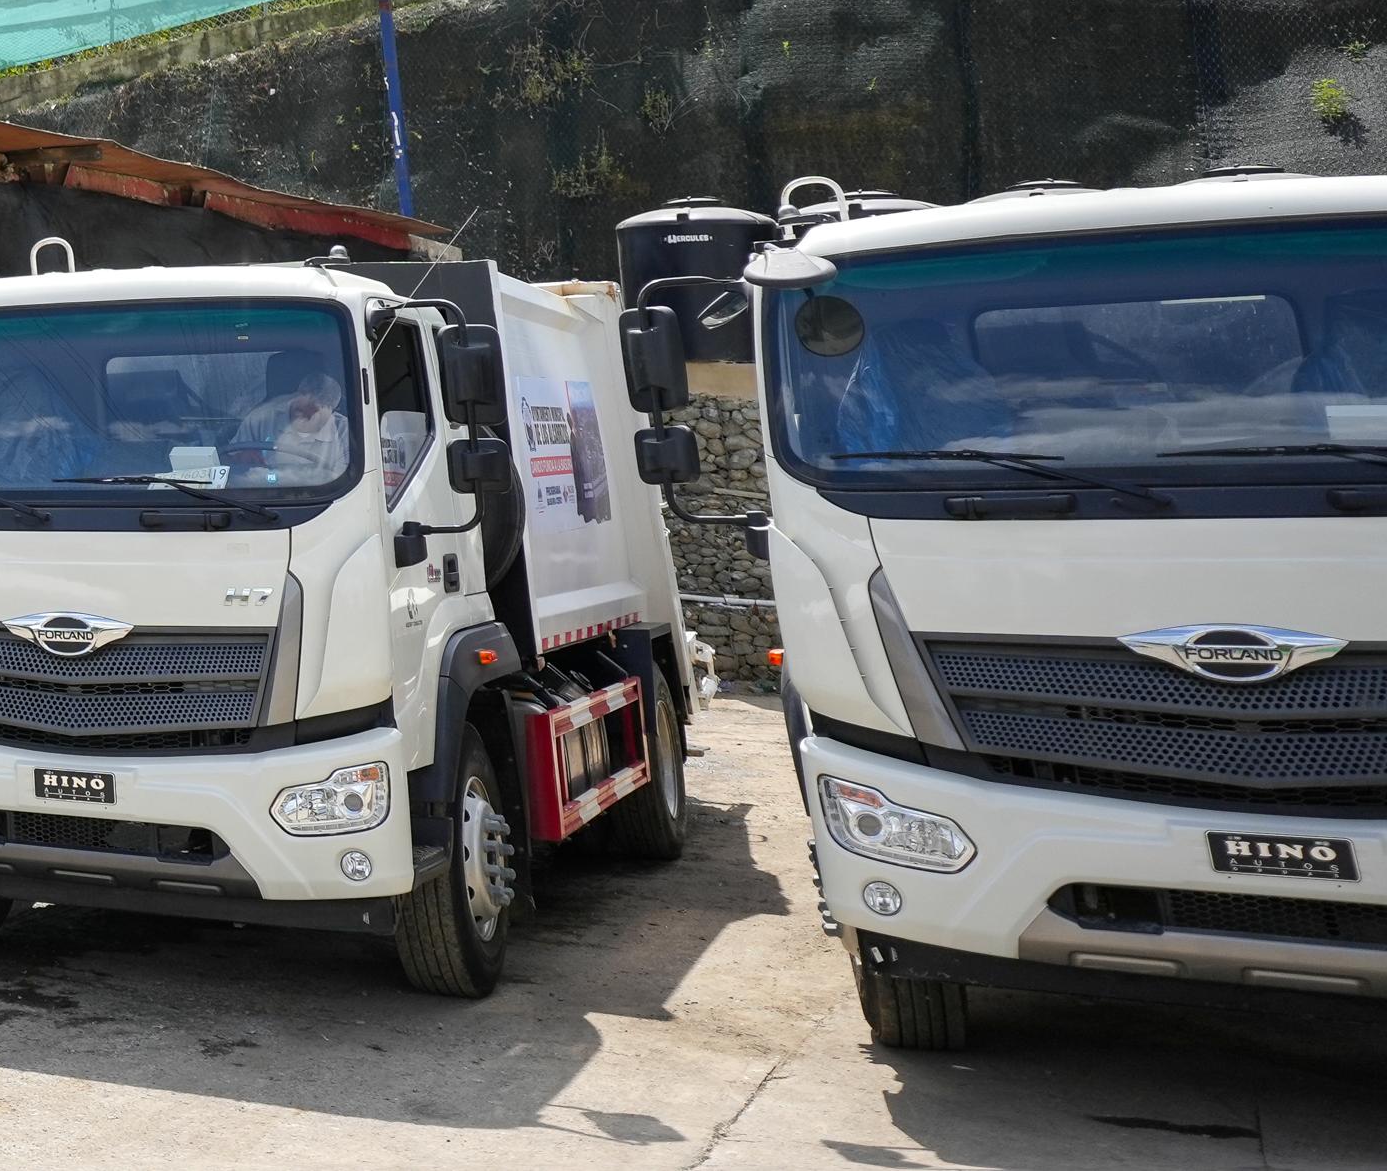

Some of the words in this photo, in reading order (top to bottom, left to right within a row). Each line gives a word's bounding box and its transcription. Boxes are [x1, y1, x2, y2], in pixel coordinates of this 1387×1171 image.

[667, 234, 709, 244] HERCULES
[223, 587, 274, 606] H7
[37, 630, 94, 641] FORLAND
[1185, 648, 1284, 661] FORLAND
[43, 774, 105, 790] HINO
[1224, 840, 1337, 862] HINO
[1229, 858, 1340, 872] AUTOS
